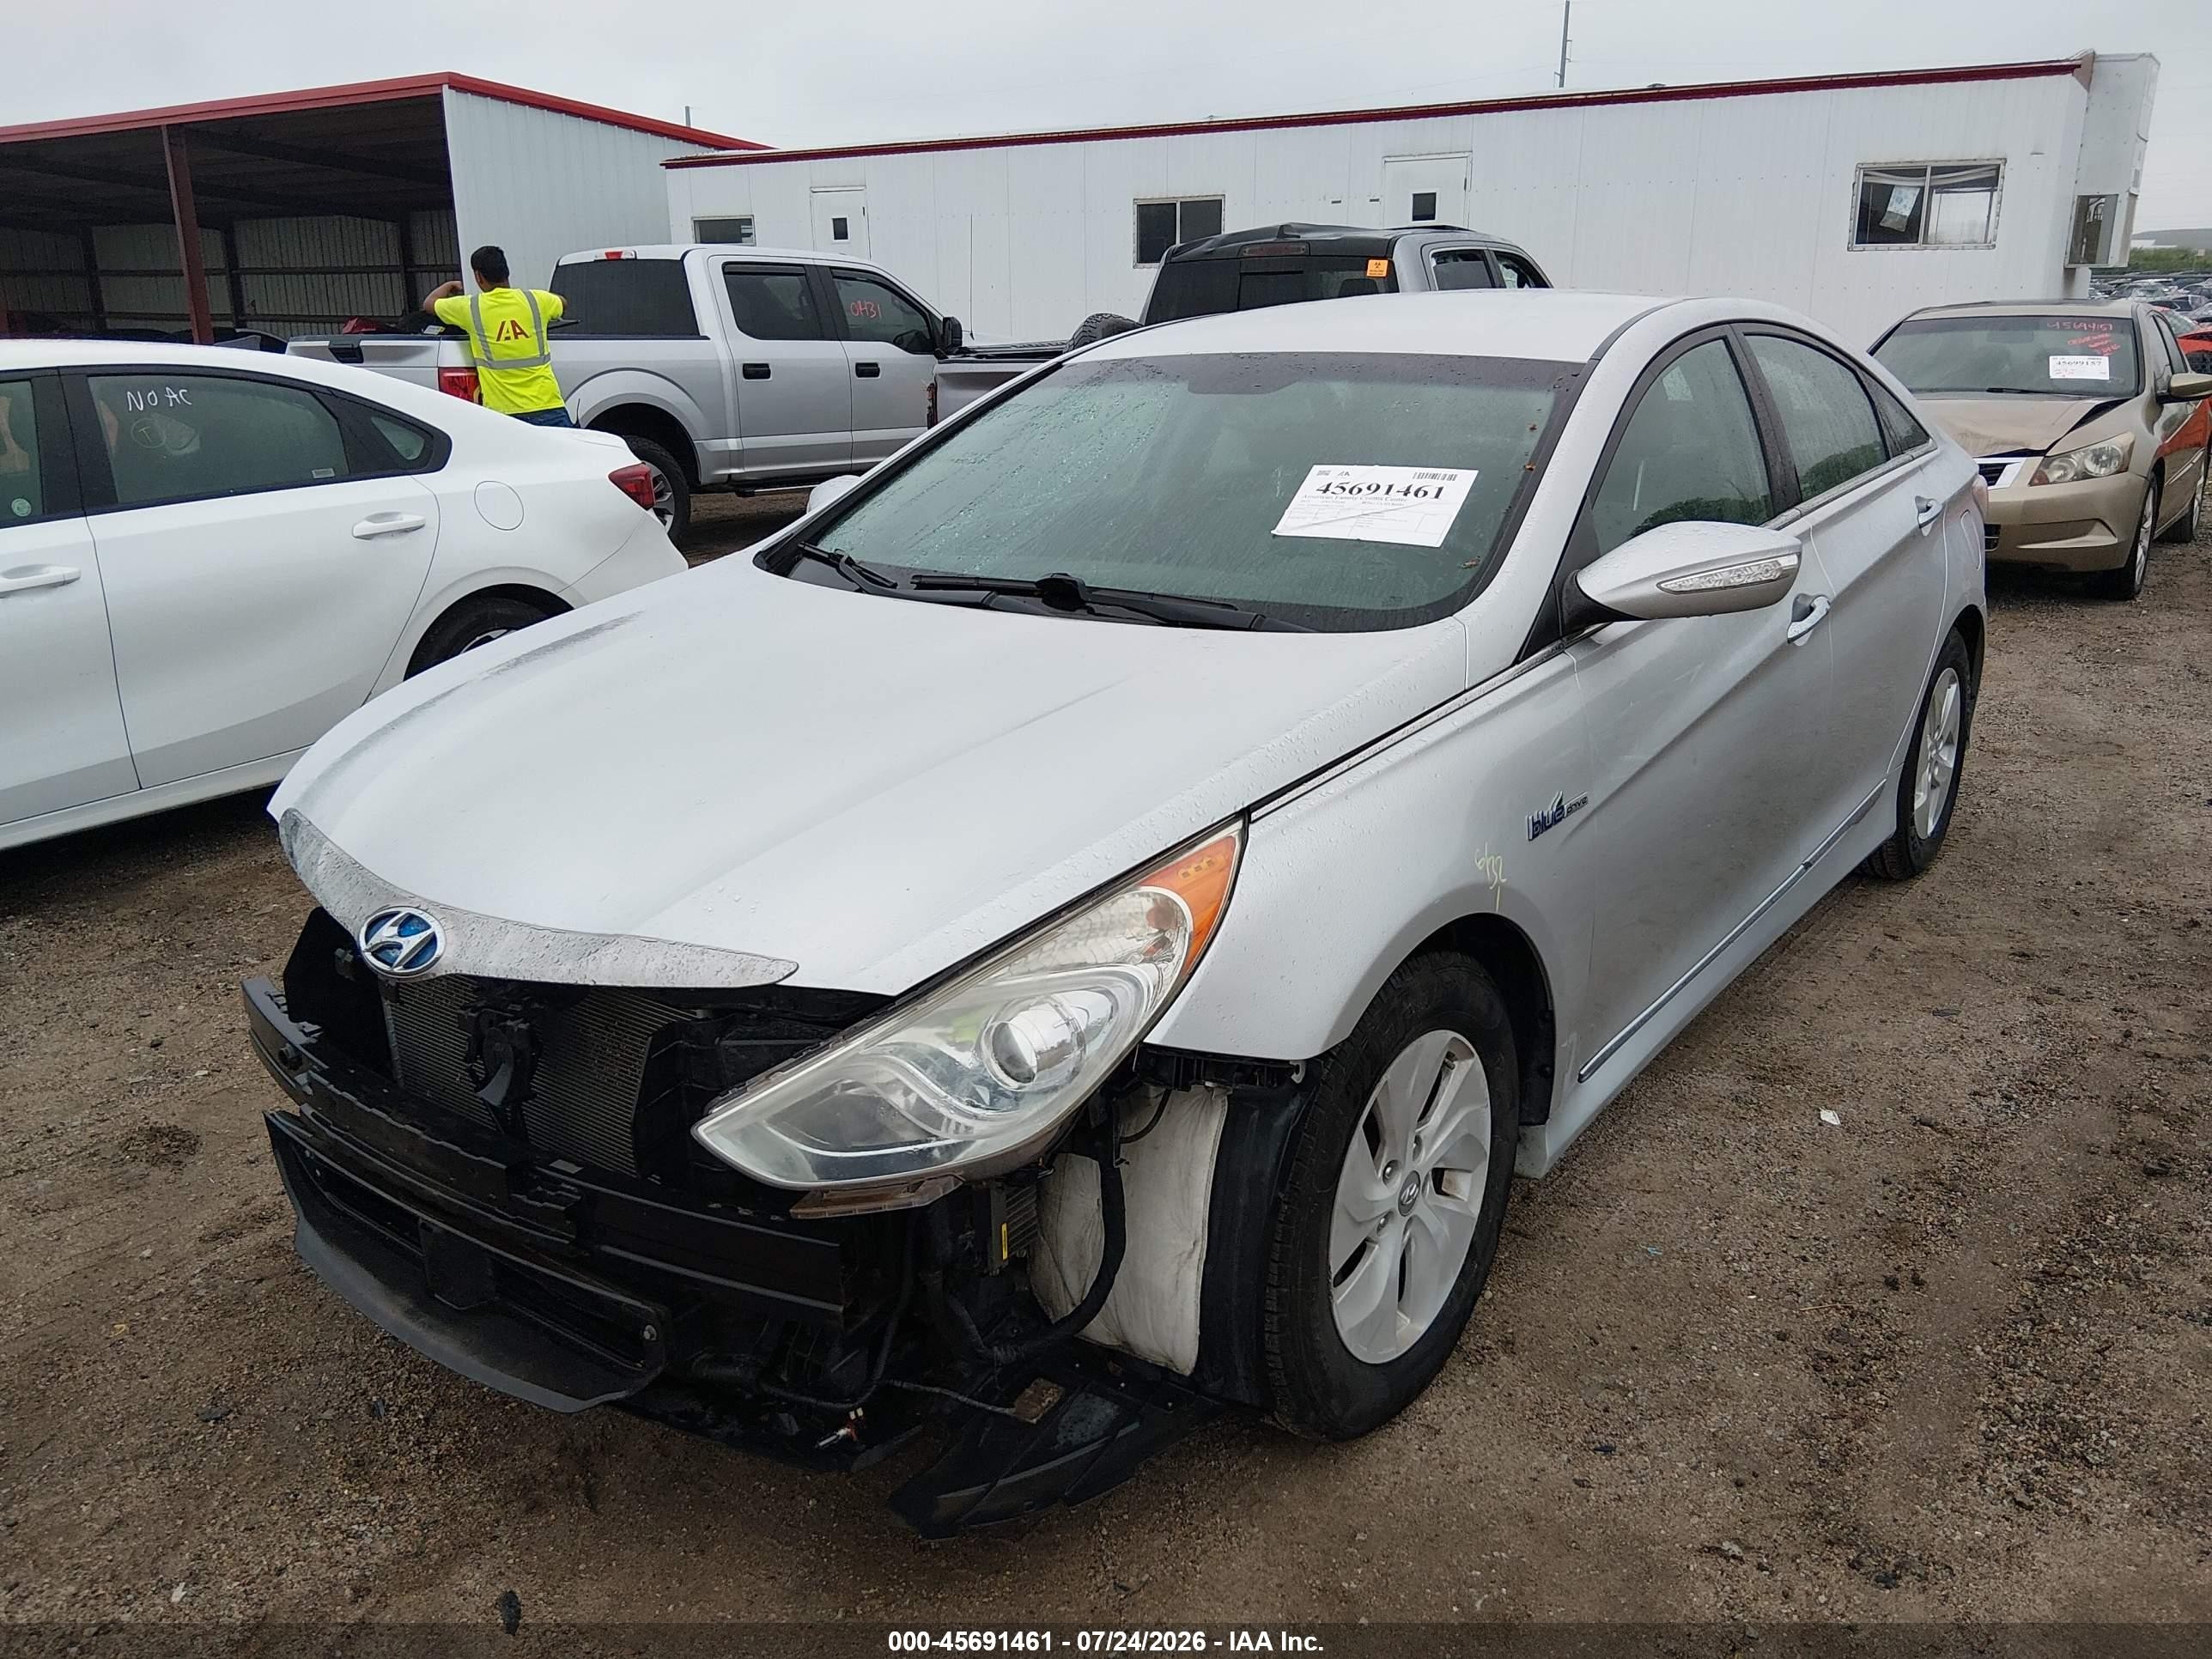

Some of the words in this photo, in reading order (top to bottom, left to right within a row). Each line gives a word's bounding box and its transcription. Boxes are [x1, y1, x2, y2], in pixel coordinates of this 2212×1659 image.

[126, 389, 159, 412] NO
[164, 386, 192, 407] AC
[1316, 481, 1445, 501] 45691461
[1525, 803, 1566, 842] blue
